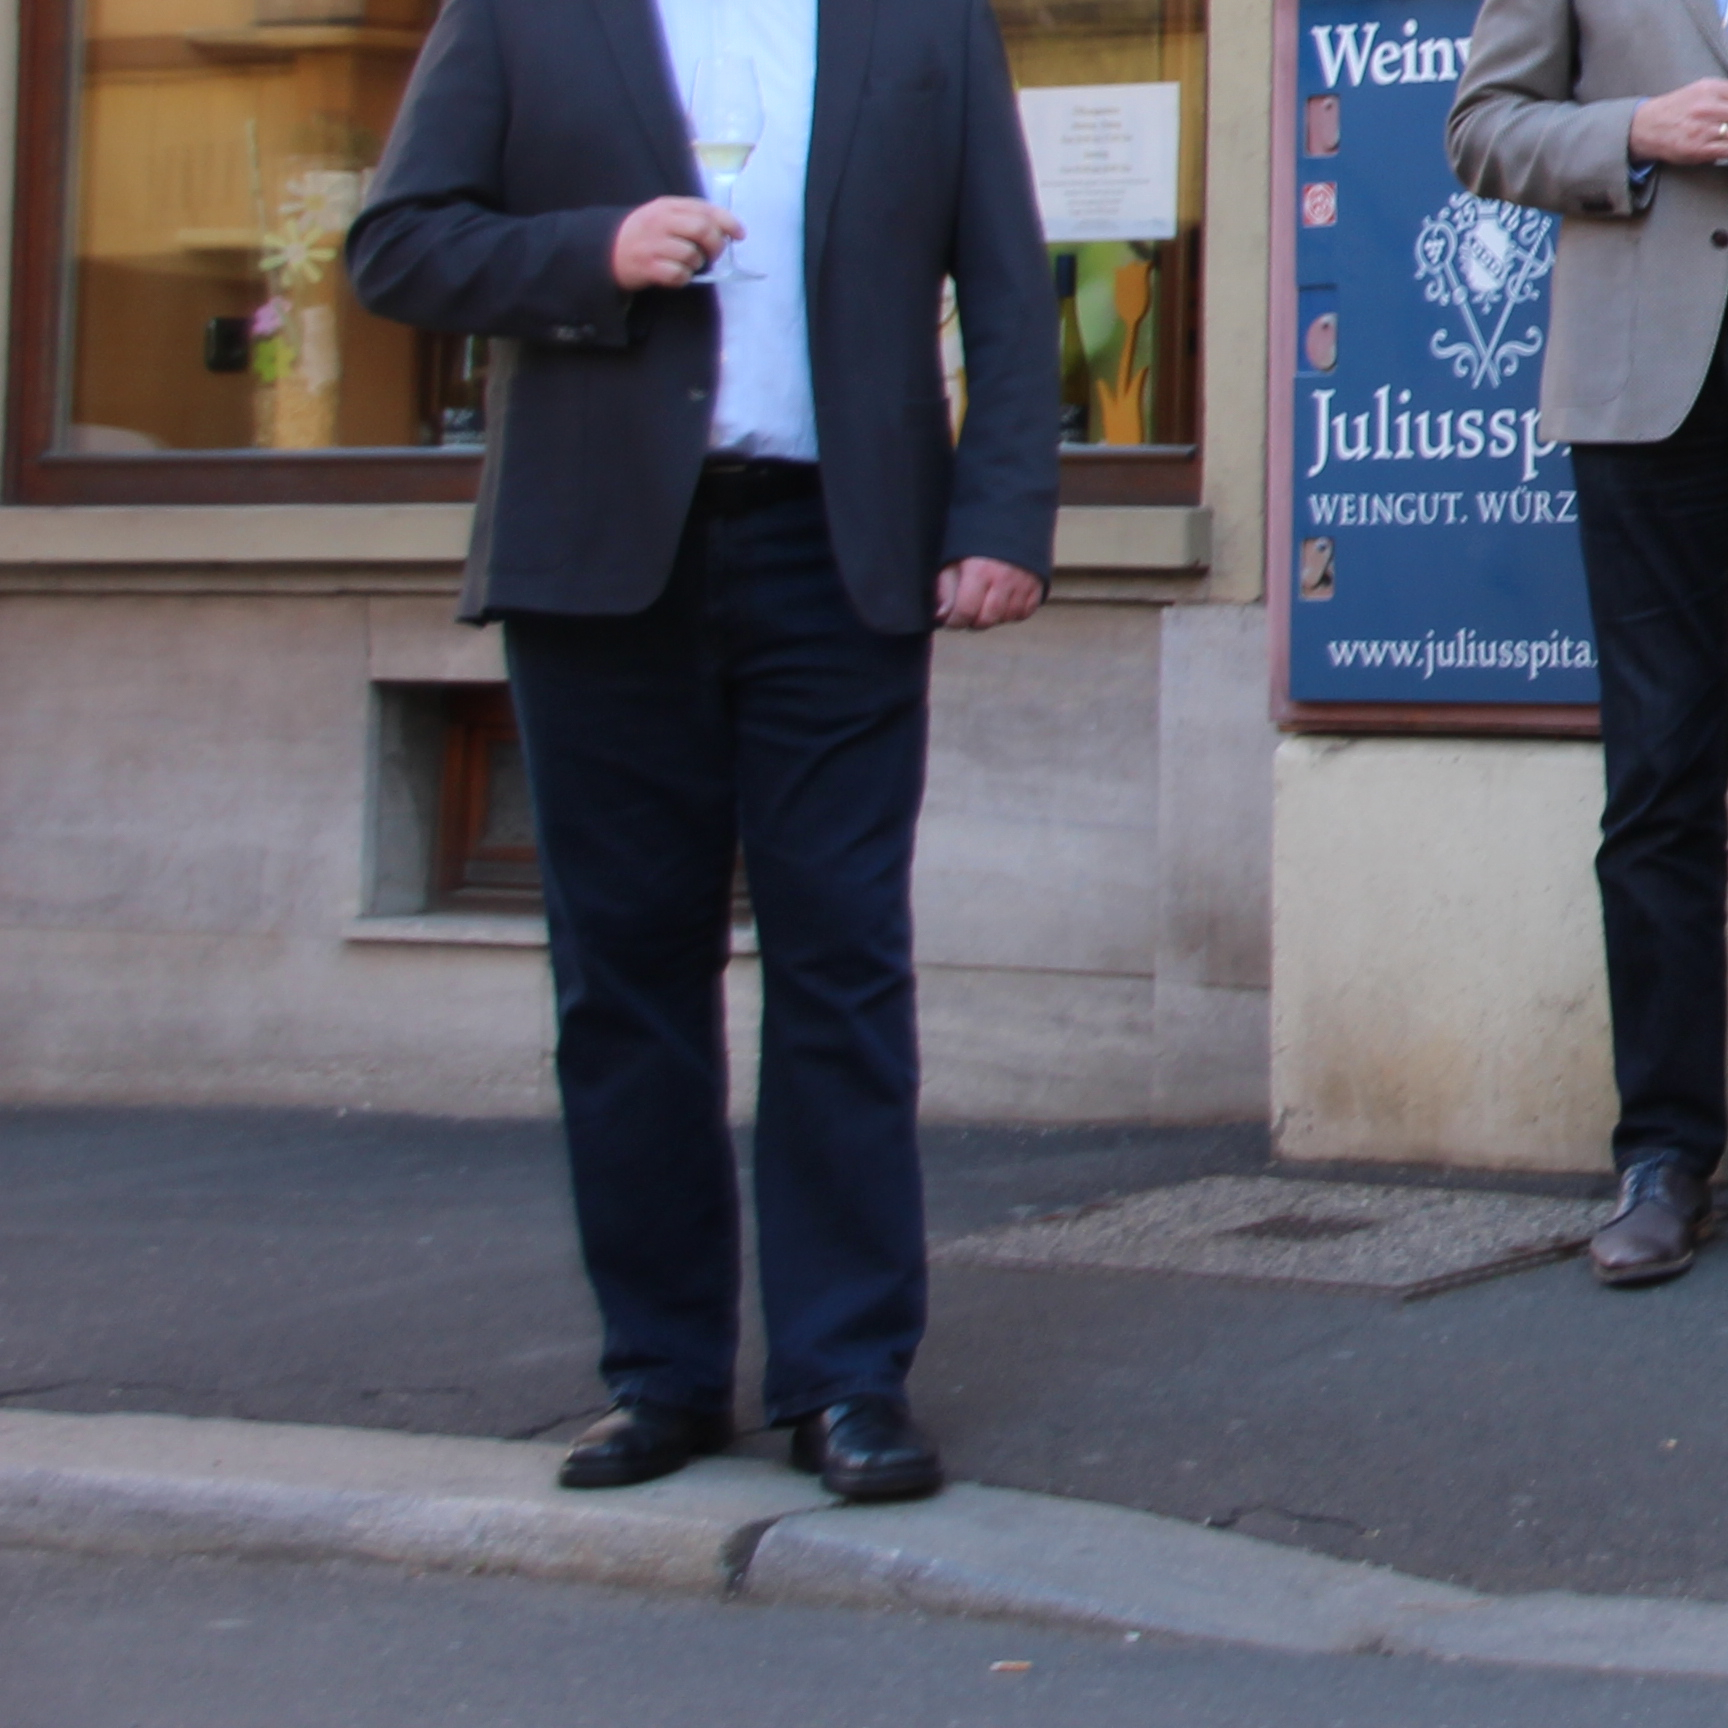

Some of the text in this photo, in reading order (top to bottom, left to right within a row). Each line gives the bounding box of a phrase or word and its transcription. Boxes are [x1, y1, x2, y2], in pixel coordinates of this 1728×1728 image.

[1307, 383, 1573, 483] Juliussp
[1308, 491, 1469, 526] WEINGUT.
[1327, 627, 1599, 681] www.juliusspita
